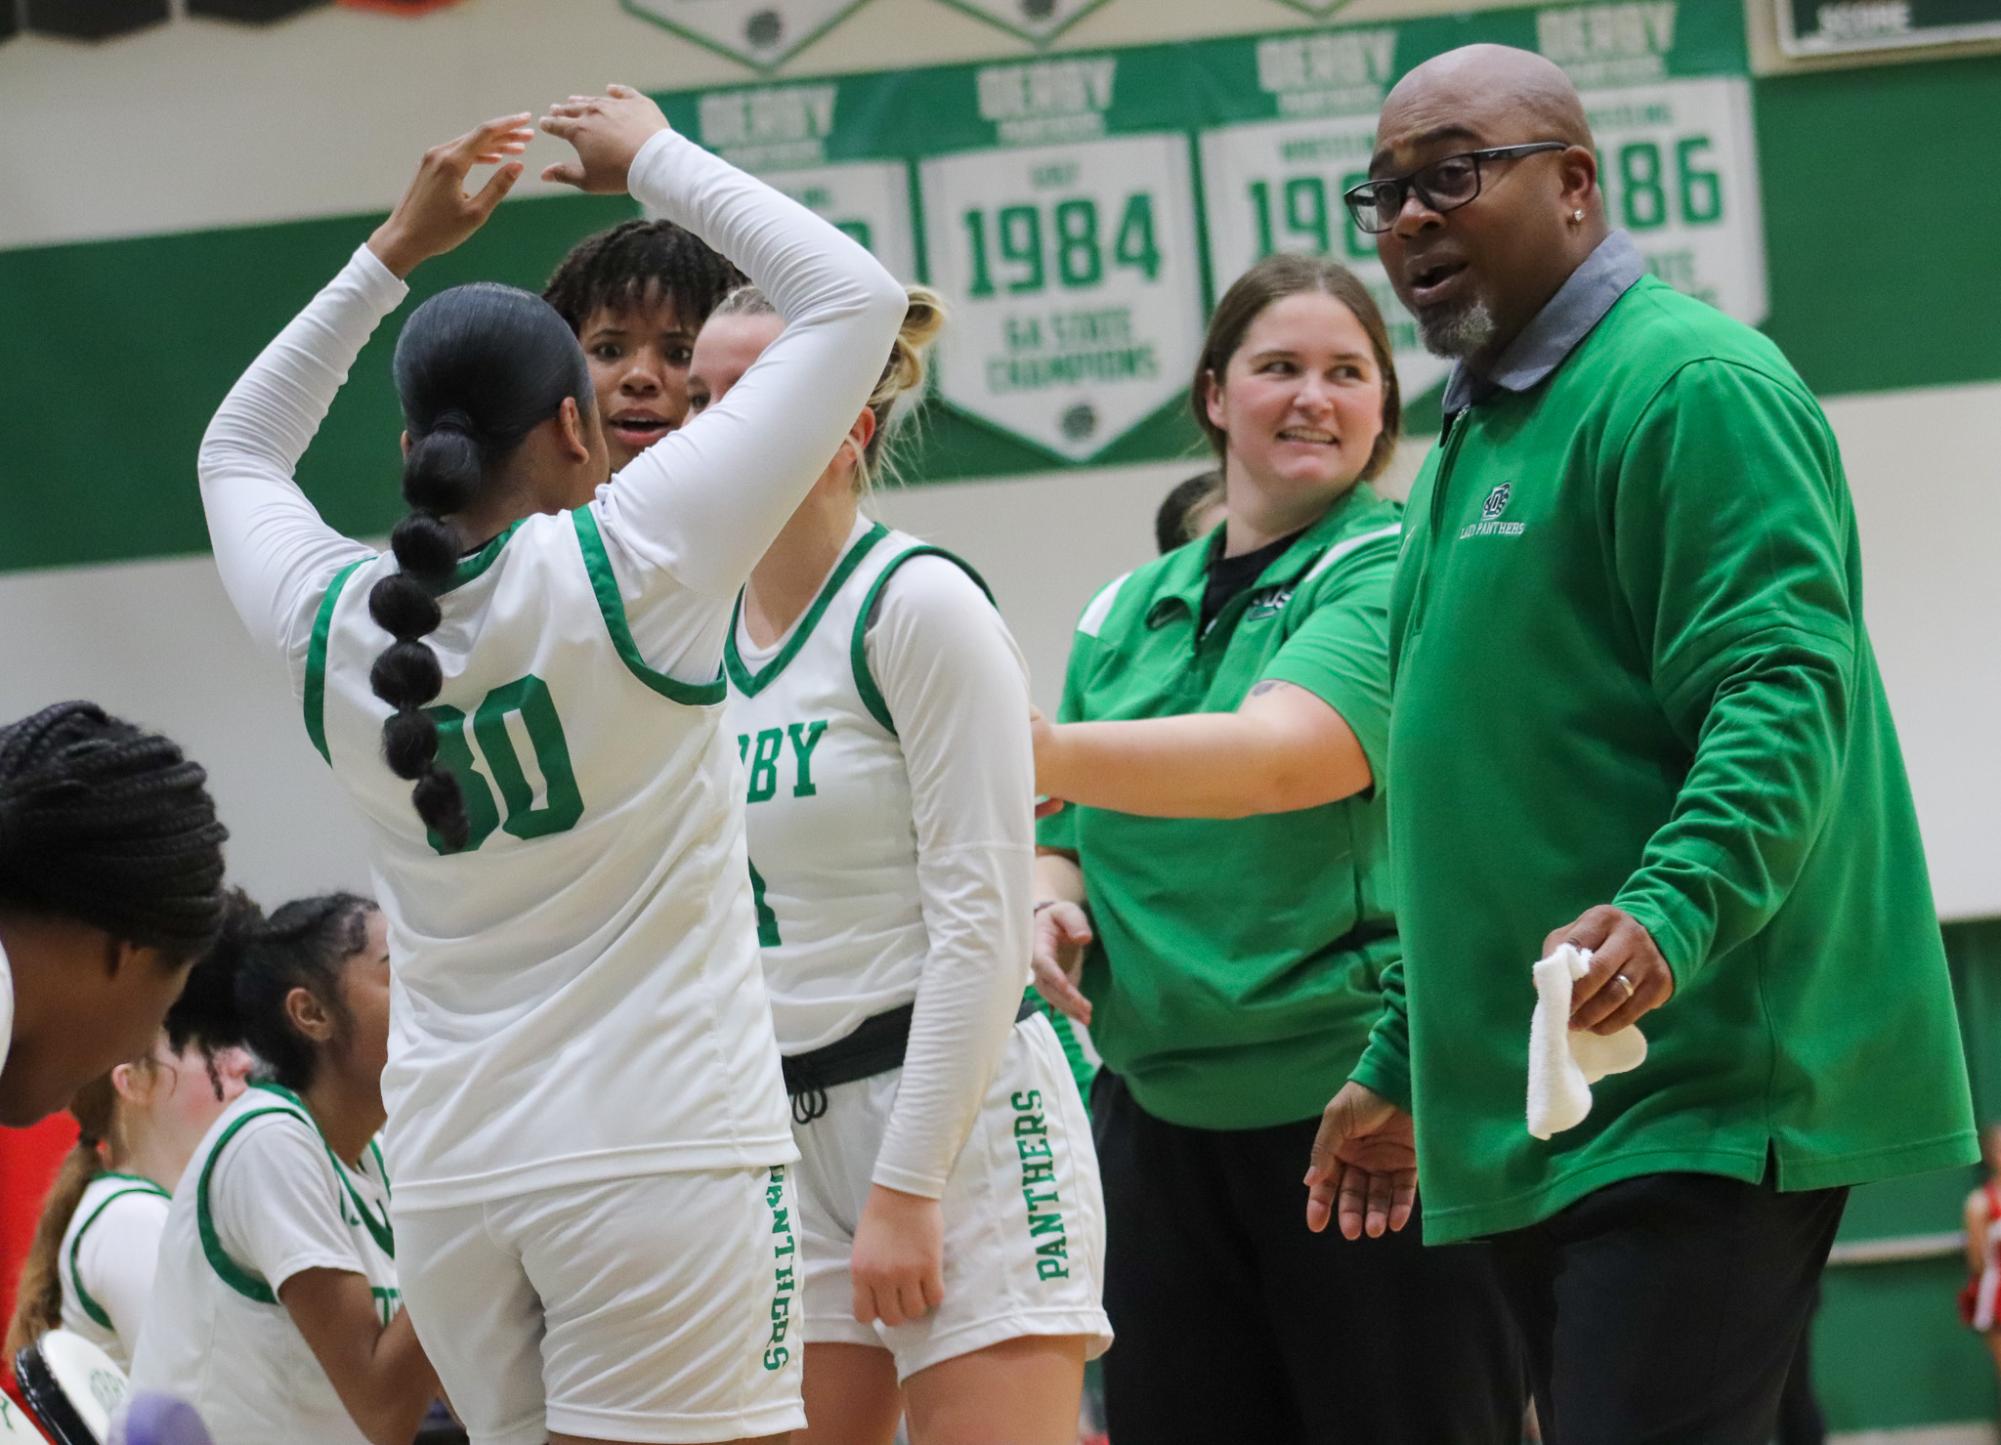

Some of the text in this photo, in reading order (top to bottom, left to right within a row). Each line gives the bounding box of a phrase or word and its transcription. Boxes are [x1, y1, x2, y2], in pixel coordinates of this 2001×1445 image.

[964, 194, 1159, 298] 1984
[986, 346, 1158, 392] CHAMPIONS
[1476, 522, 1525, 536] PANTHERS
[1010, 1089, 1070, 1281] PANTHERS
